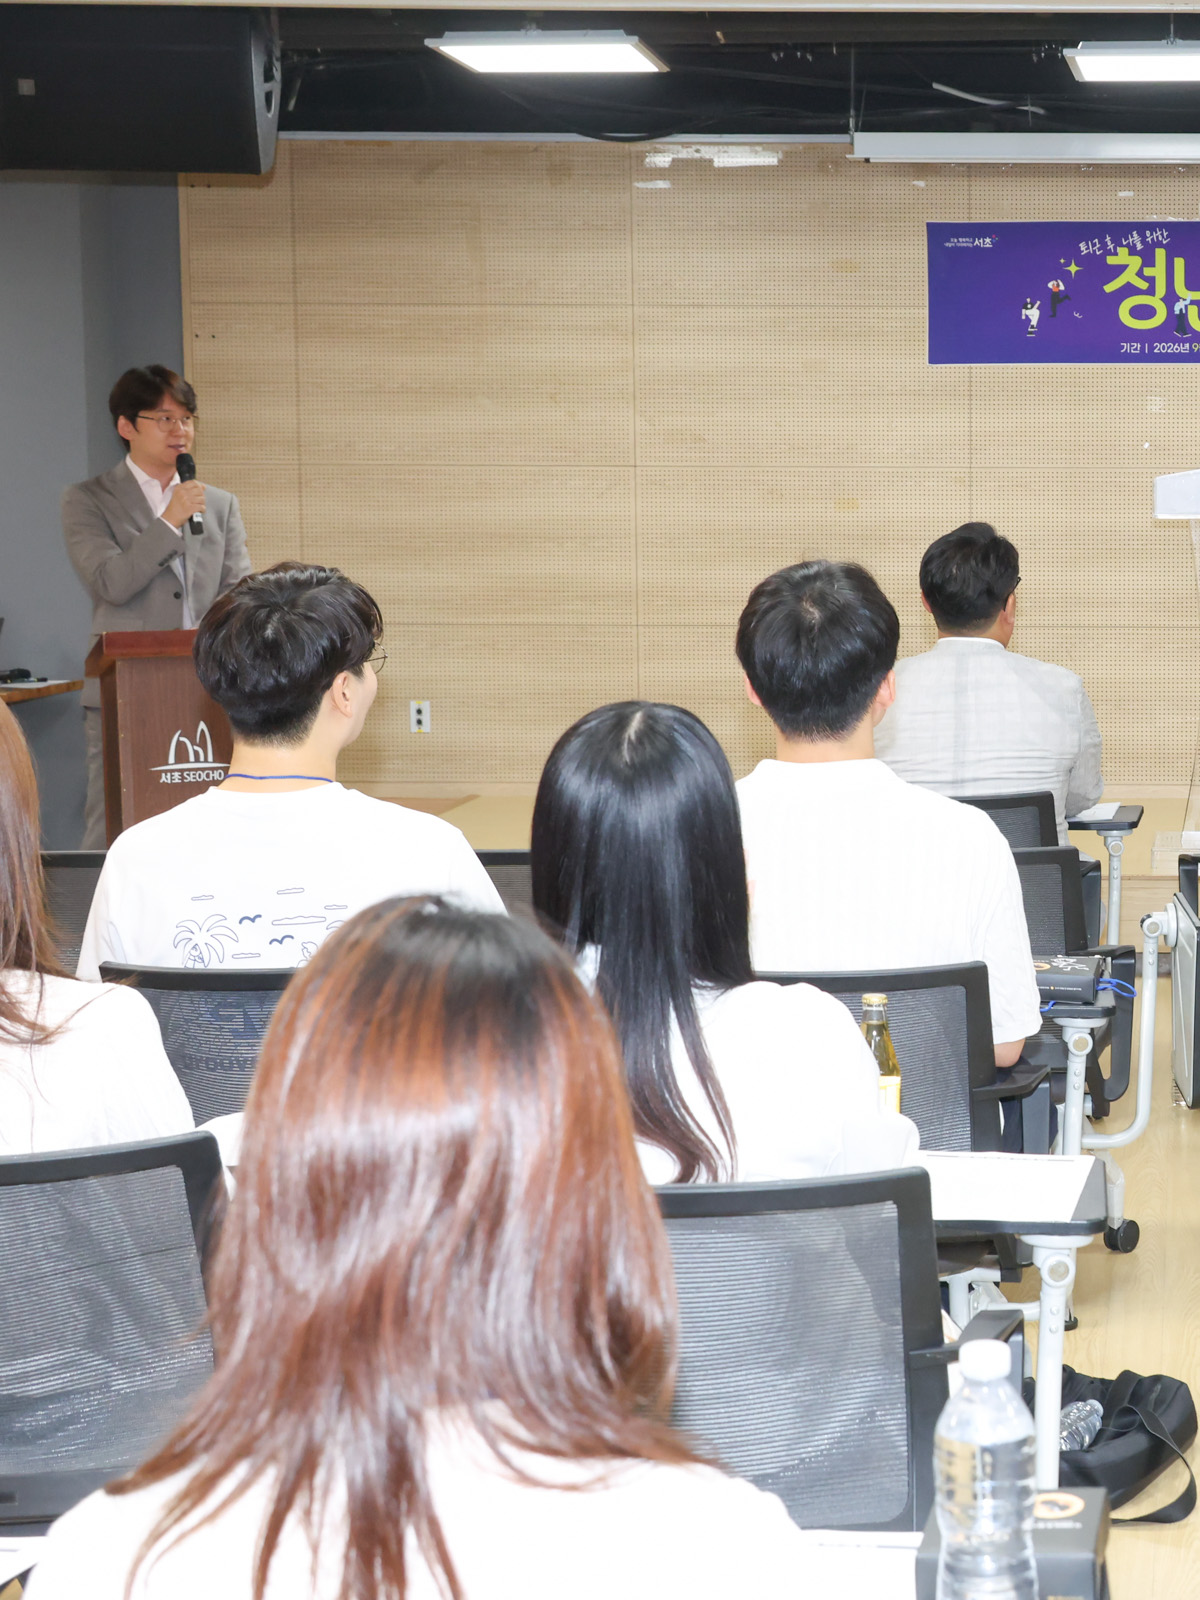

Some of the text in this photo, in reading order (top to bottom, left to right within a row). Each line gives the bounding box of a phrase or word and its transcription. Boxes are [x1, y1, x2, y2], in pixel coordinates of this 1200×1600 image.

[973, 236, 993, 248] 서초
[1079, 238, 1103, 256] 퇴근
[1122, 230, 1144, 251] 나를
[1145, 227, 1171, 245] 위한
[1120, 342, 1141, 354] 기간
[1153, 342, 1190, 354] 2026년
[160, 769, 225, 784] 서초 SEOCHO
